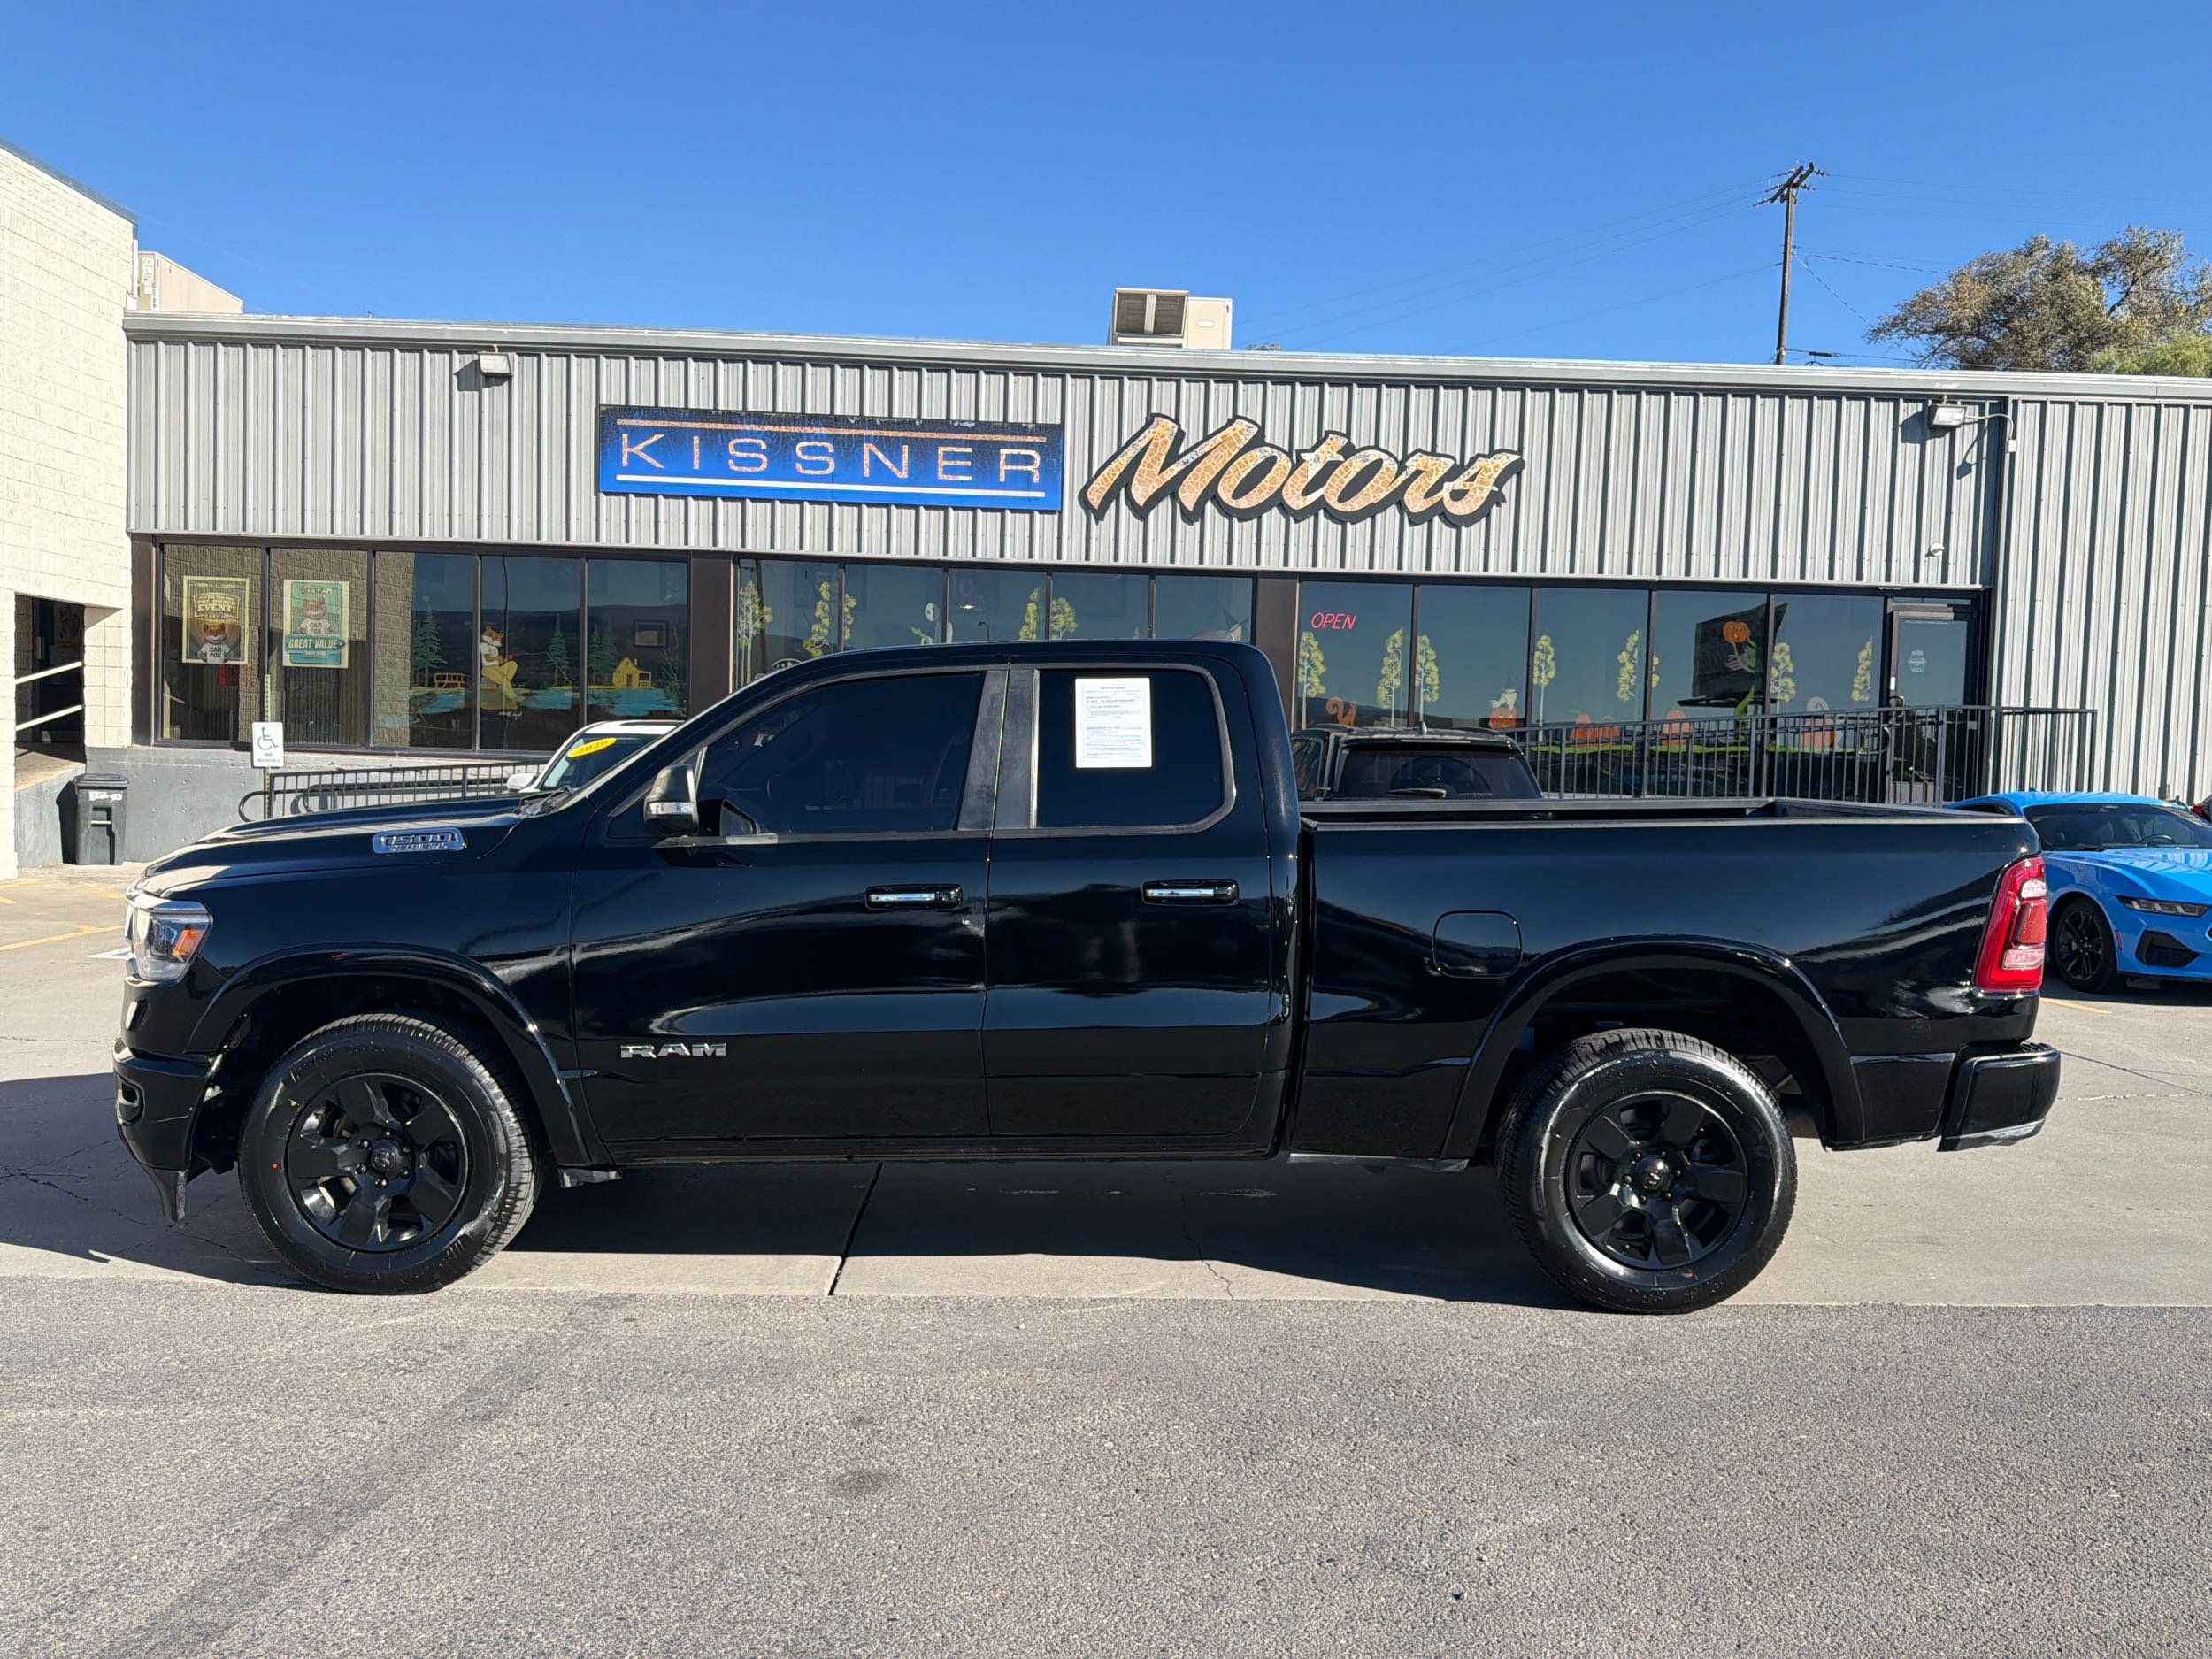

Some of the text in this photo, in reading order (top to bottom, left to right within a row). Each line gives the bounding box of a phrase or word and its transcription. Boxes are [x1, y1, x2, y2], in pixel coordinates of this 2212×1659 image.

[621, 414, 1524, 524] KISSNER Motors
[197, 604, 237, 613] EVENT!
[1310, 611, 1357, 630] OPEN
[288, 638, 338, 649] GREAT VALUE
[620, 1042, 727, 1059] RAM
